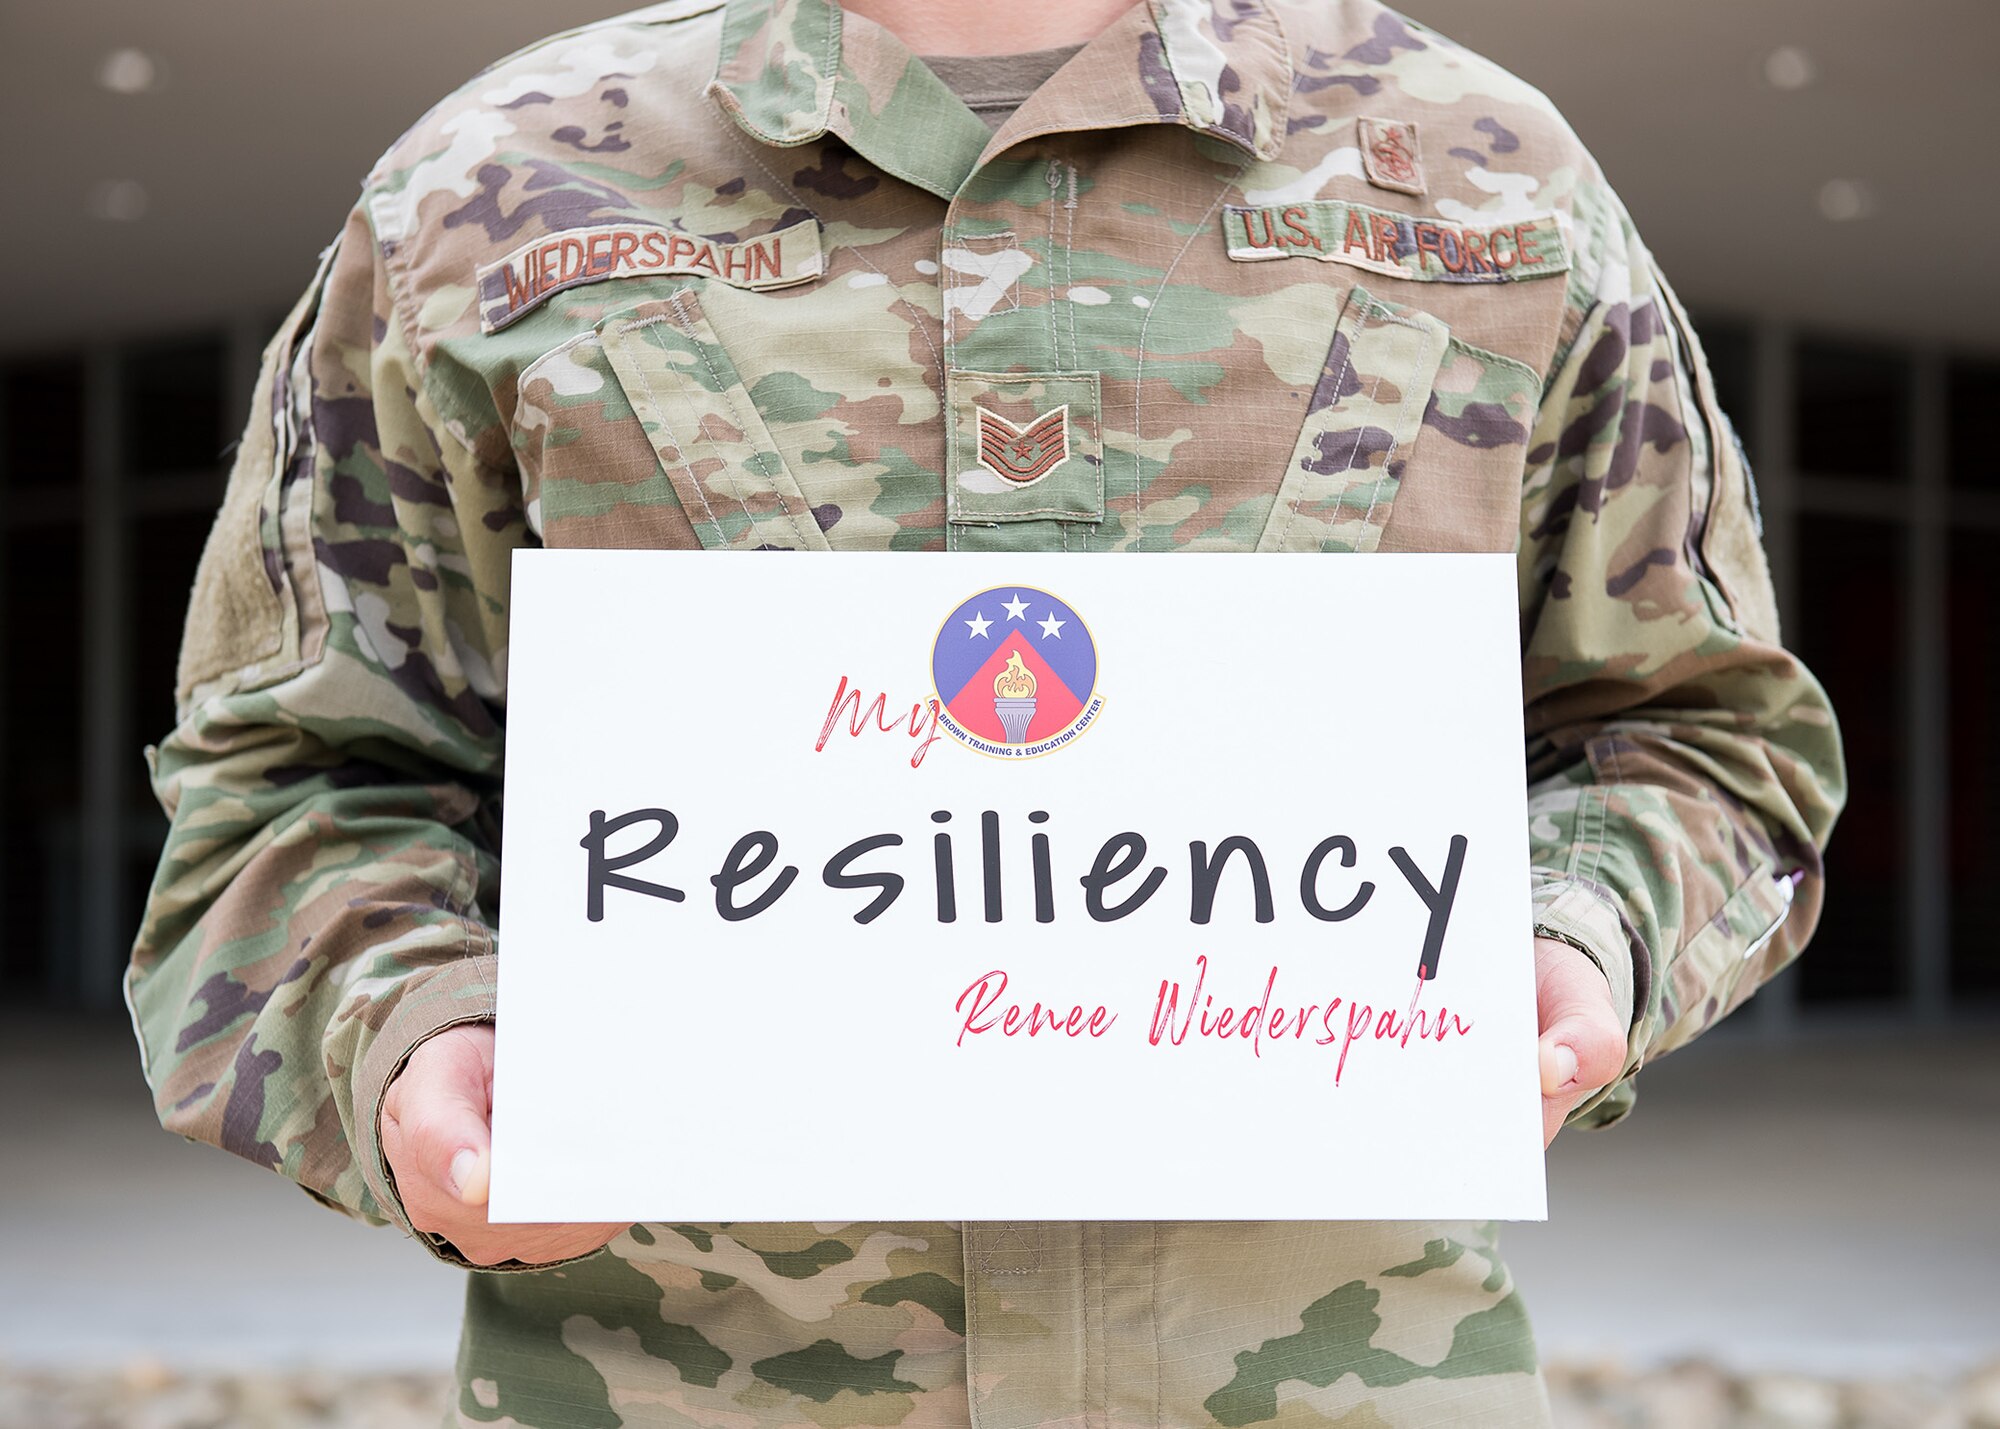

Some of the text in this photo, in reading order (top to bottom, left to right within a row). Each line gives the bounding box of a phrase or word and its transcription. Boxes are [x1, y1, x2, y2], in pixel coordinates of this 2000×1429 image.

[503, 231, 782, 313] WIEDERSPAHN
[1243, 207, 1545, 274] U.S. AIR FORCE
[815, 675, 942, 769] My
[938, 713, 968, 741] BROWN
[968, 736, 1013, 756] TRAINING
[1015, 748, 1022, 757] &
[1025, 728, 1077, 756] EDUCATION
[1075, 699, 1102, 731] CENTER
[580, 807, 1468, 981] Resiliency
[955, 954, 1473, 1088] Renee Wiederspahn
